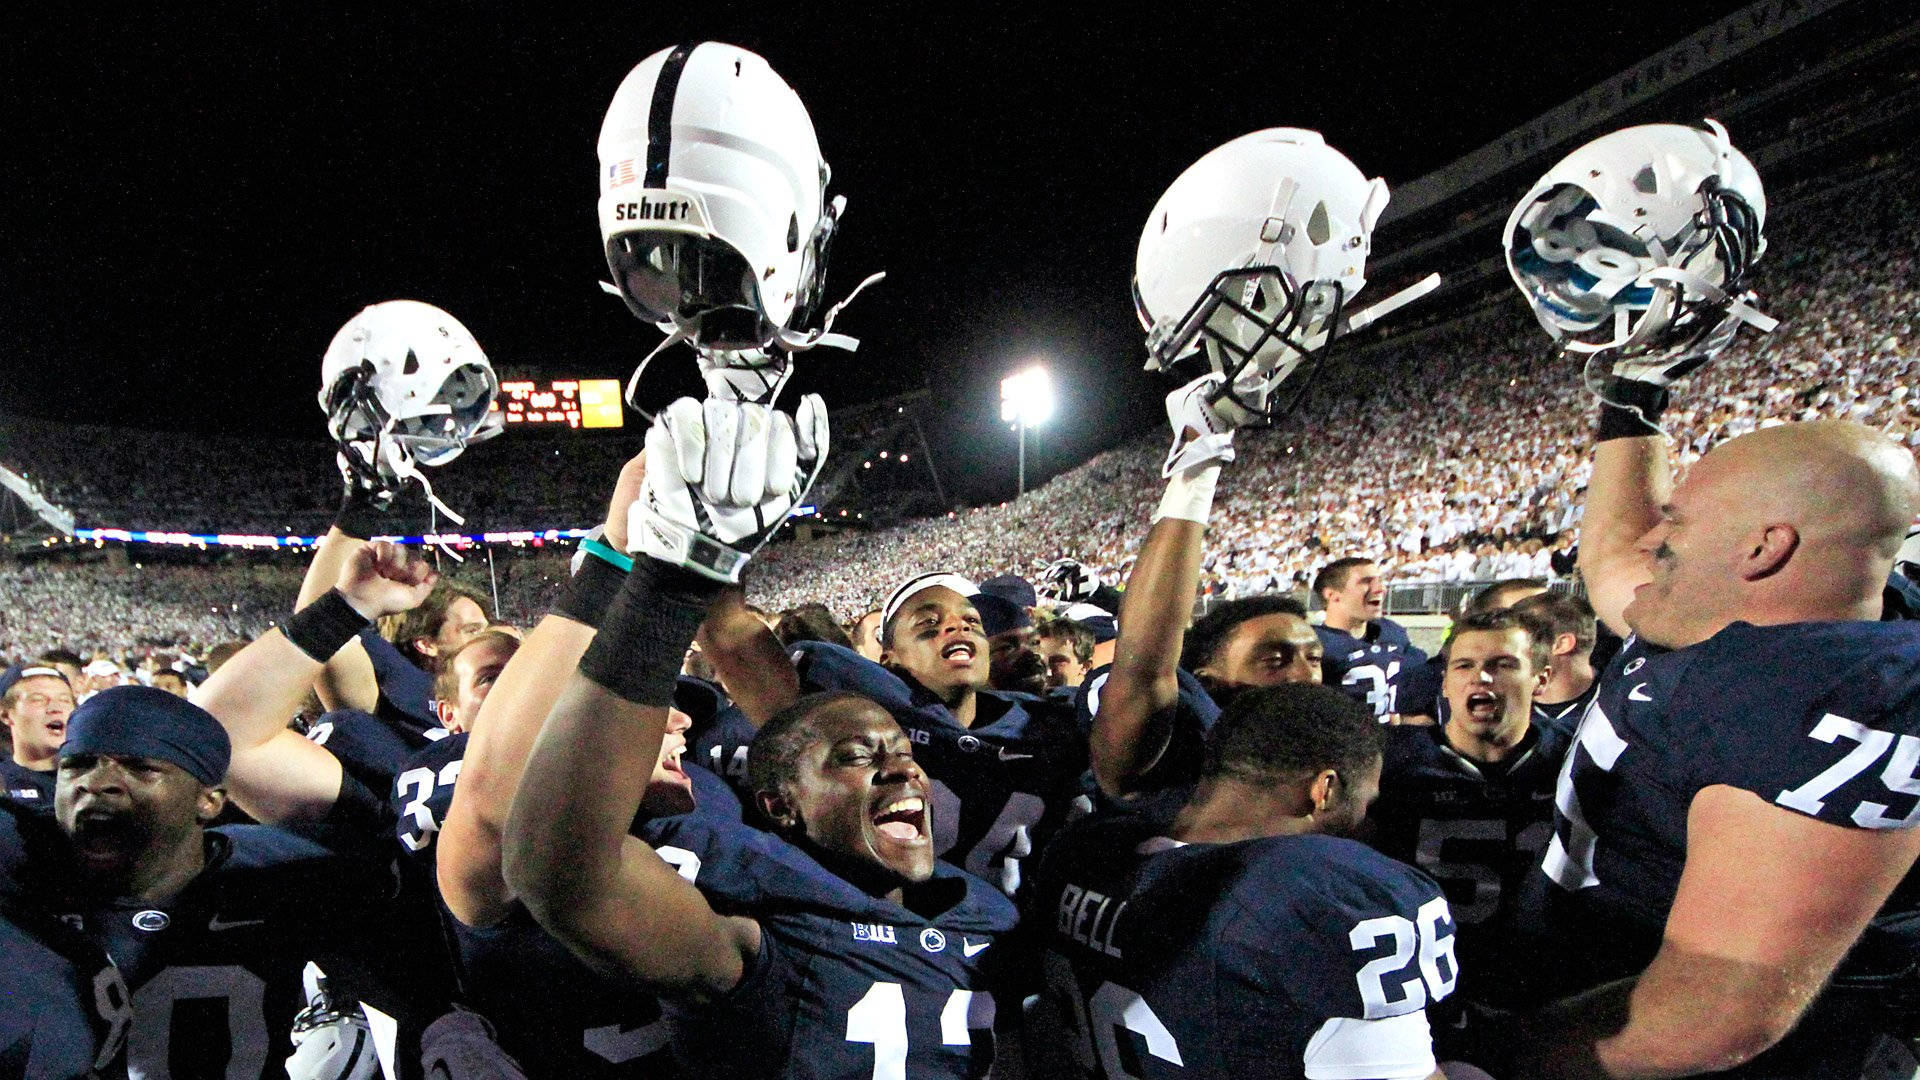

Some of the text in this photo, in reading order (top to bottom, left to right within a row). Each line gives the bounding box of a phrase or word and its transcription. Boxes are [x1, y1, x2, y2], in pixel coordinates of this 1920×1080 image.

[616, 196, 689, 220] schutt
[1775, 712, 1920, 830] 75
[1058, 882, 1128, 959] BELL
[1348, 896, 1460, 1020] 26
